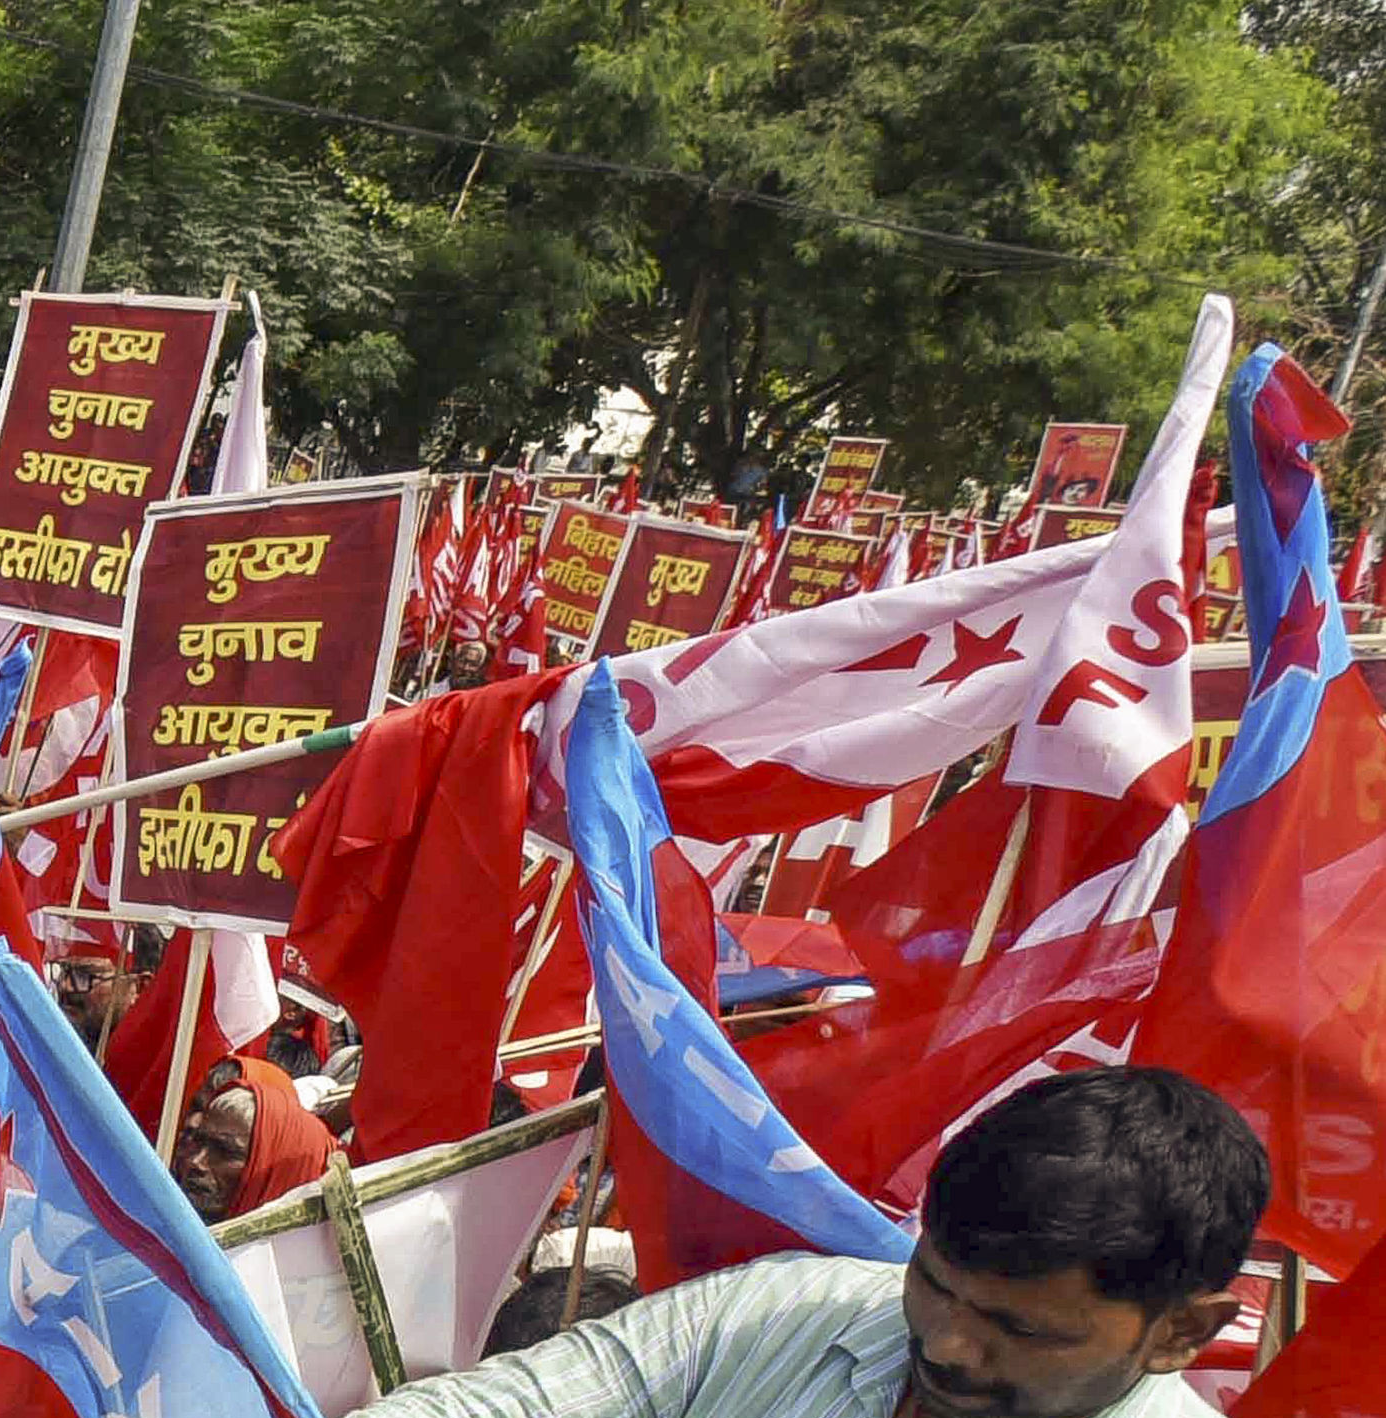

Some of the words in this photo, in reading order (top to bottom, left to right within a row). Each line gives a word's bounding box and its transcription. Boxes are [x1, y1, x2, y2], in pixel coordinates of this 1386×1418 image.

[67, 324, 166, 377] मुख्य
[48, 388, 154, 440] चुनाव
[14, 451, 153, 506] आयुक्त
[89, 526, 131, 598] दो
[204, 534, 332, 604] मुख्य
[545, 555, 609, 598] महिल
[646, 553, 711, 607] मुख्य
[177, 620, 324, 687] चुनाव
